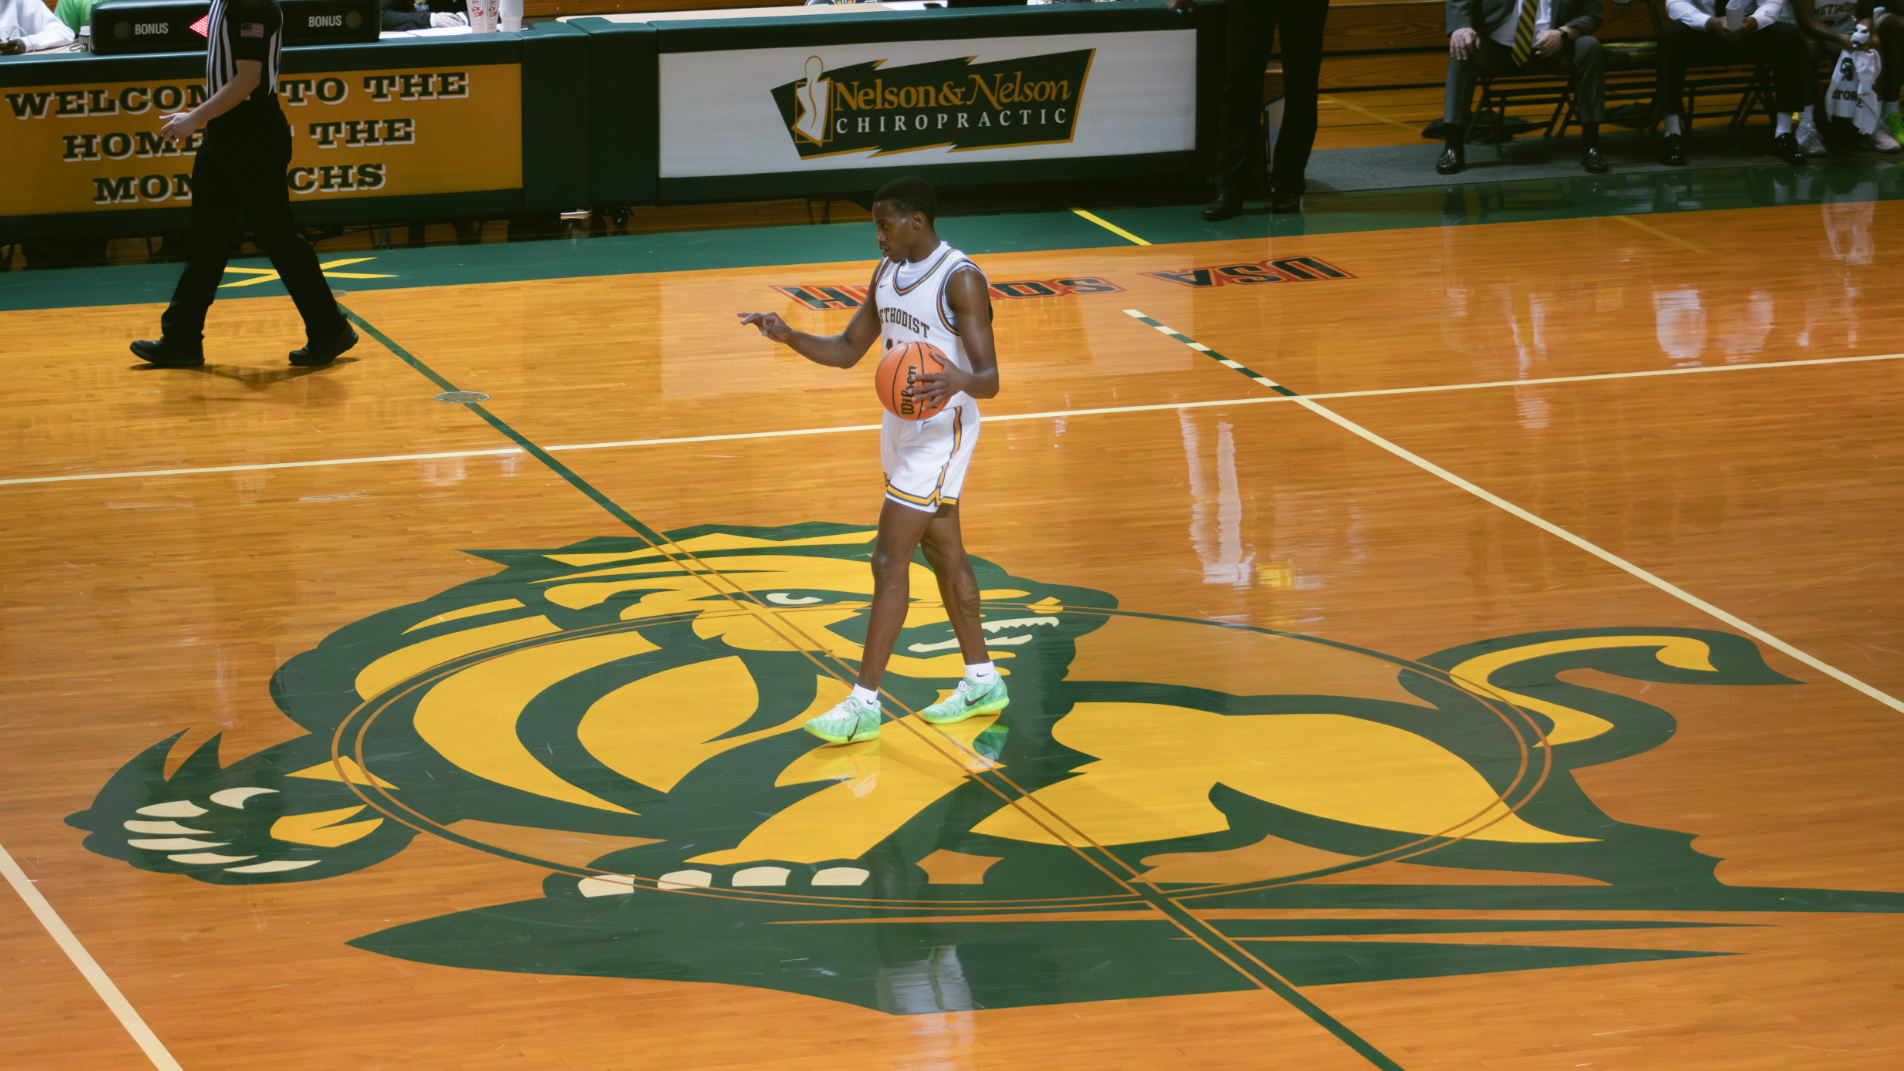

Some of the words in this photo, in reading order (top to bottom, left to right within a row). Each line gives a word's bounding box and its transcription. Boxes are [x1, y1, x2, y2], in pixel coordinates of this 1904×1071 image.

[134, 22, 169, 35] BONUS
[308, 15, 342, 28] BONUS
[5, 83, 252, 120] WELCO
[279, 77, 349, 106] TO
[363, 72, 469, 102] THE
[834, 78, 938, 111] Nelson
[966, 71, 1072, 110] Nelson
[309, 118, 415, 149] THE
[836, 108, 1067, 134] CHIROPRACTIC
[93, 163, 386, 204] MOCHS
[1140, 256, 1358, 288] USA
[769, 276, 1126, 311] SOH
[879, 307, 930, 339] ETHODIST
